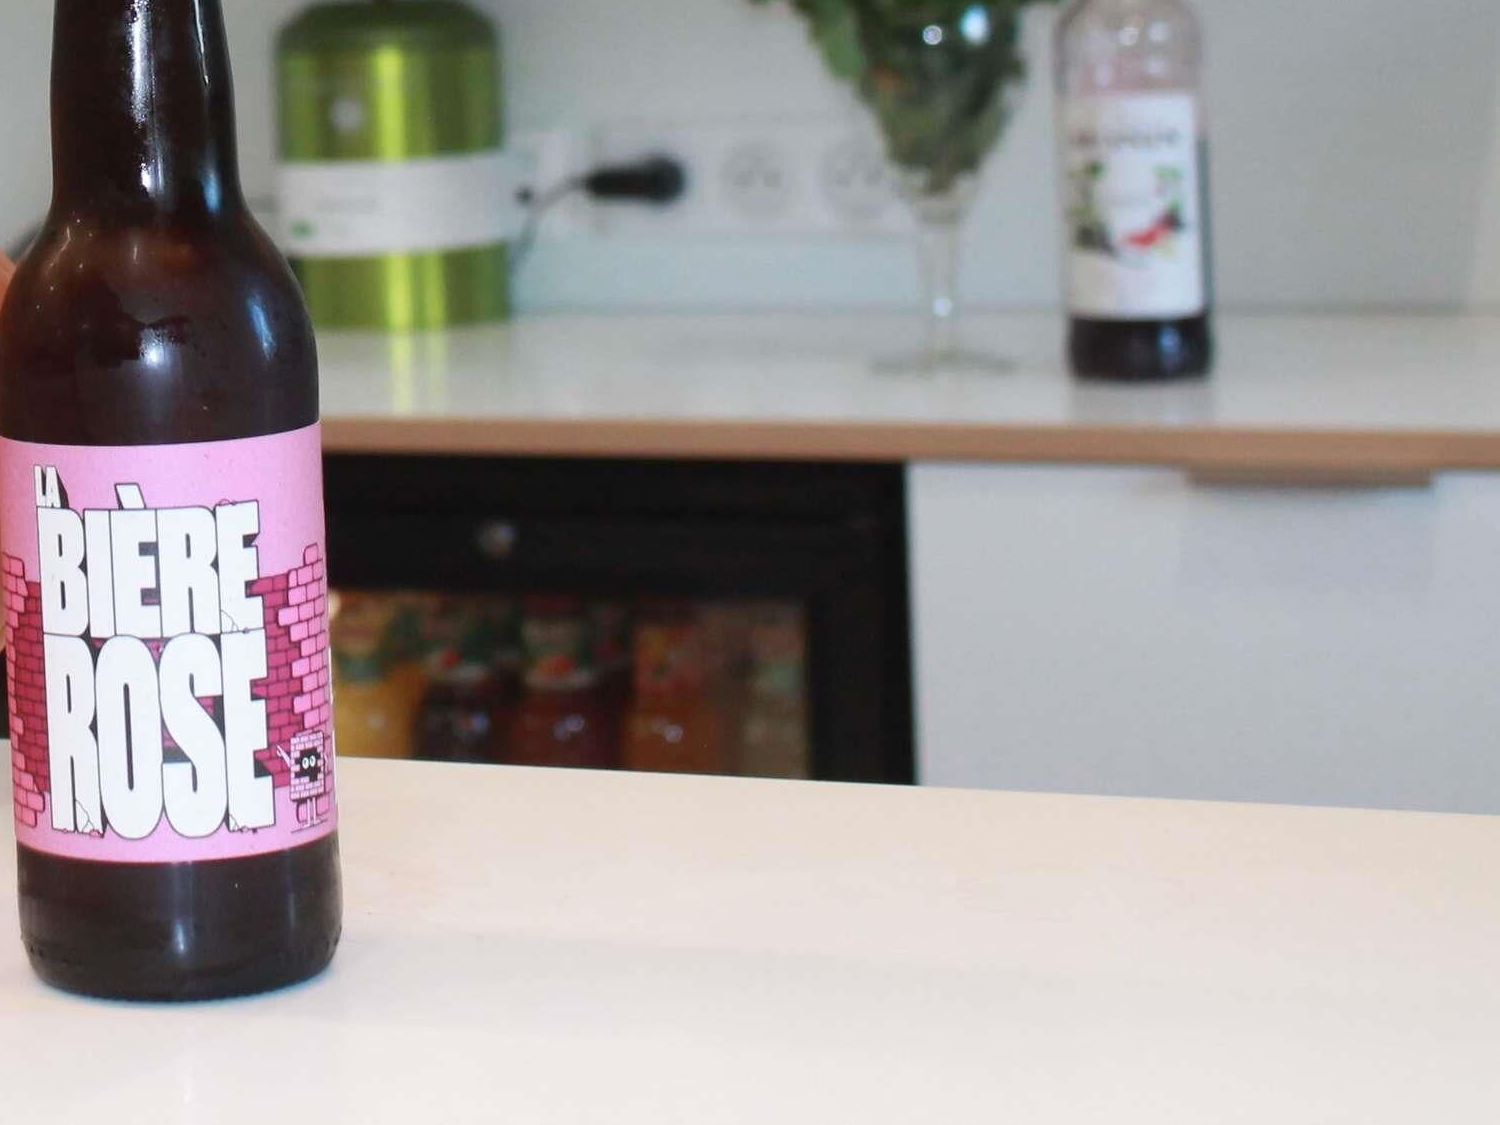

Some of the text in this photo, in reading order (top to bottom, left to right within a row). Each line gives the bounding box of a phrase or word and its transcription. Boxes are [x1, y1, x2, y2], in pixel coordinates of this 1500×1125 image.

[33, 463, 69, 509] LA
[36, 482, 265, 638] BIÈRE
[42, 628, 277, 841] ROSE
